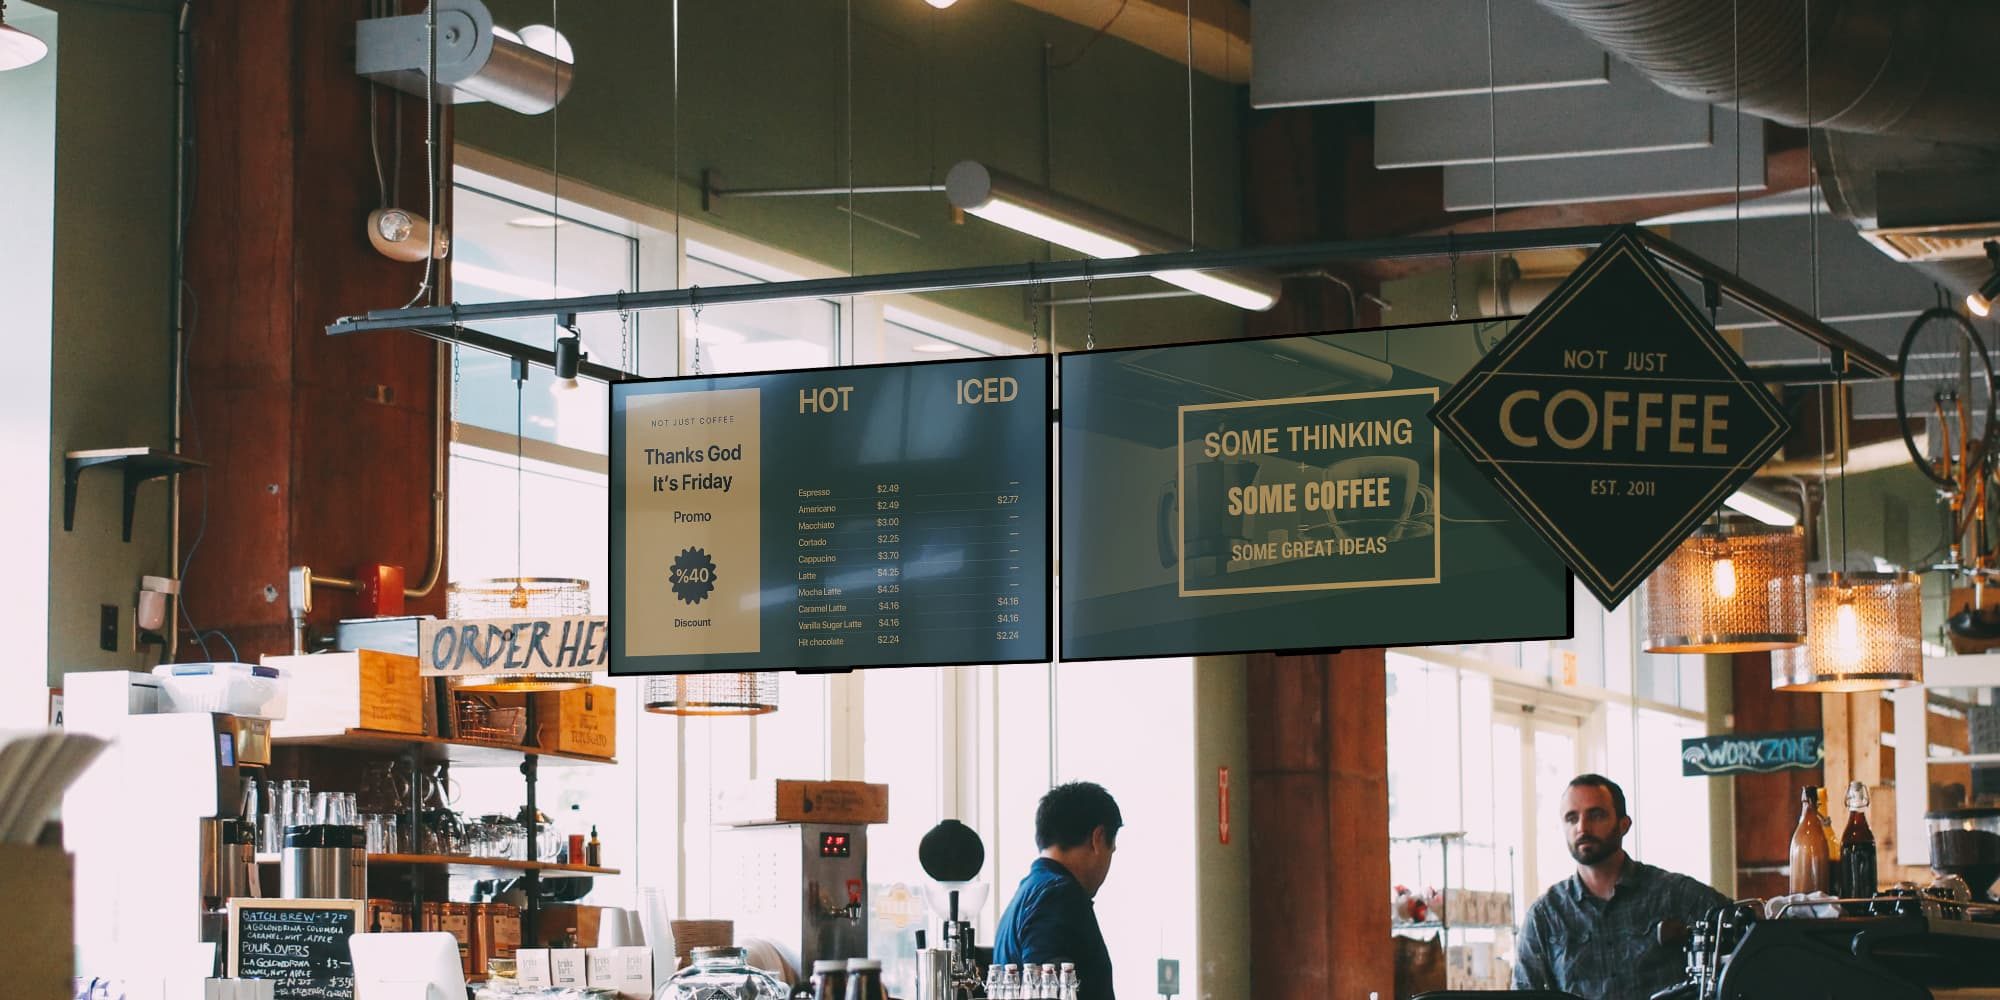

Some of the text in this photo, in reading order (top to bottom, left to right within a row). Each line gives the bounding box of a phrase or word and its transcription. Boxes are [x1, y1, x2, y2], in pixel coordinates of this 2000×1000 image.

[1564, 350, 1668, 373] NOT JUST
[957, 376, 1018, 405] ICED
[799, 386, 854, 413] HOT
[651, 416, 735, 428] NOT JUST COFFEE
[1499, 389, 1729, 454] COFFEE
[1204, 418, 1413, 458] SOME THINKING
[644, 444, 742, 465] Thanks God
[653, 473, 733, 492] It’s Friday
[1590, 479, 1655, 496] EST. 2011
[798, 484, 899, 499] Espresso $2.49
[1228, 477, 1390, 516] SOME COFFEE
[798, 495, 1019, 514] Americano $2.49 $2.77
[674, 511, 712, 523] Promo
[798, 517, 899, 530] Macchiato $3.00
[798, 534, 899, 547] Cortado $2.25
[1232, 536, 1387, 562] SOME GREAT IDEAS
[798, 551, 899, 564] Cappucino $3.70
[676, 567, 709, 584] %40
[798, 568, 899, 580] Latte $4.25
[798, 584, 899, 597] Mocha Latte $4.25
[798, 597, 1019, 614] Caramel Latte $4.16 $4.16
[674, 618, 711, 628] Discount
[798, 614, 1019, 630] Vanilla Sugar Latte $4.16 $4.16
[432, 621, 553, 670] ORDER
[810, 637, 844, 646] chocolate
[877, 635, 899, 644] $2.24
[996, 631, 1019, 640] $2.24
[242, 912, 276, 921] BATCH
[242, 942, 310, 957] POUR OVERS
